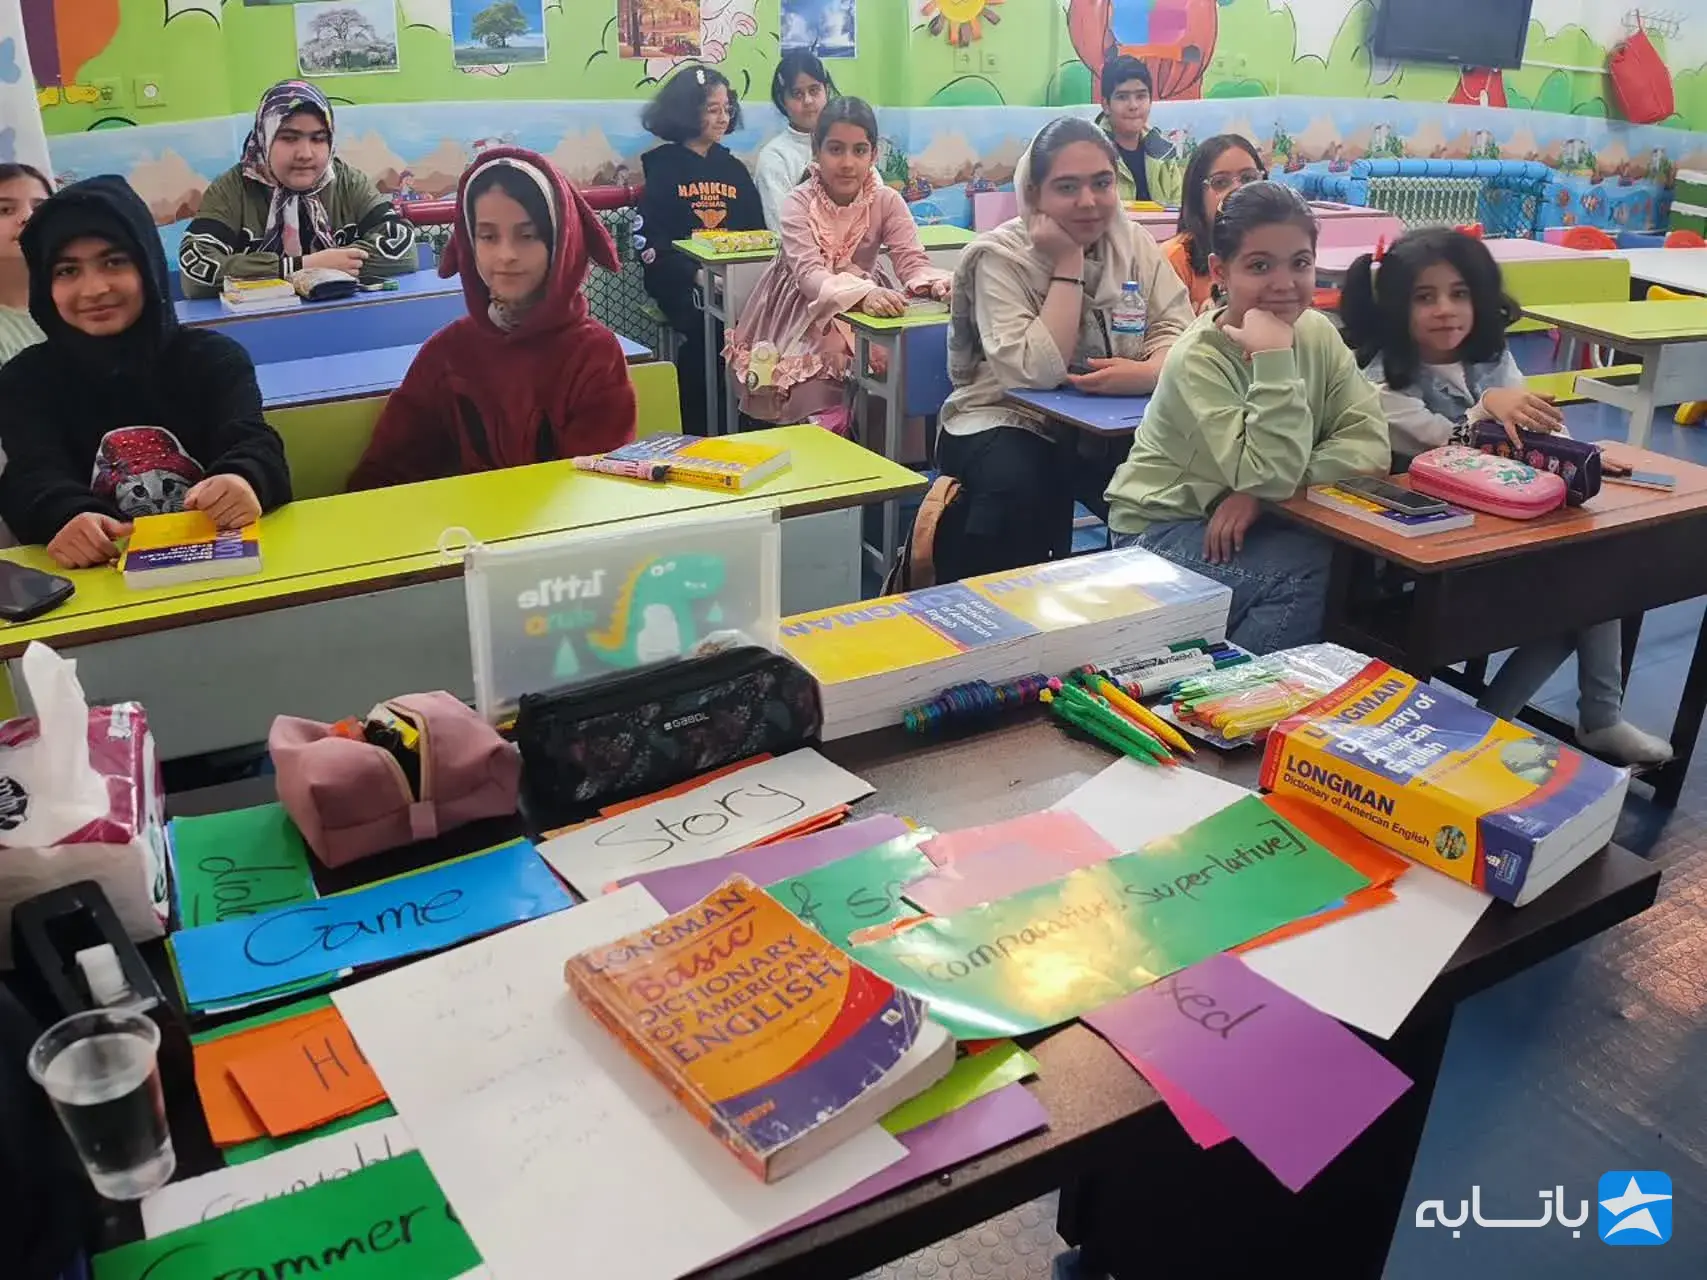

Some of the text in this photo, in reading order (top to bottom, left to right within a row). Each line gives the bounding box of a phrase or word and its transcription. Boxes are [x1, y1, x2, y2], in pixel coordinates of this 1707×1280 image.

[678, 182, 737, 200] HANKER
[1304, 679, 1406, 738] LNGMAN
[1415, 693, 1436, 709] of
[1363, 724, 1437, 764] American
[1384, 742, 1447, 774] English
[595, 783, 804, 862] Story
[1284, 773, 1430, 847] Dictionary of American English
[1287, 755, 1395, 816] LONGMAN
[244, 889, 466, 966] Game
[585, 889, 746, 974] LONGMAN
[627, 920, 755, 1002] Basic
[638, 932, 799, 1027] DICTIONARY
[652, 1015, 686, 1043] OF
[696, 946, 820, 1024] AMERICAN
[670, 960, 845, 1065] ENGLISH
